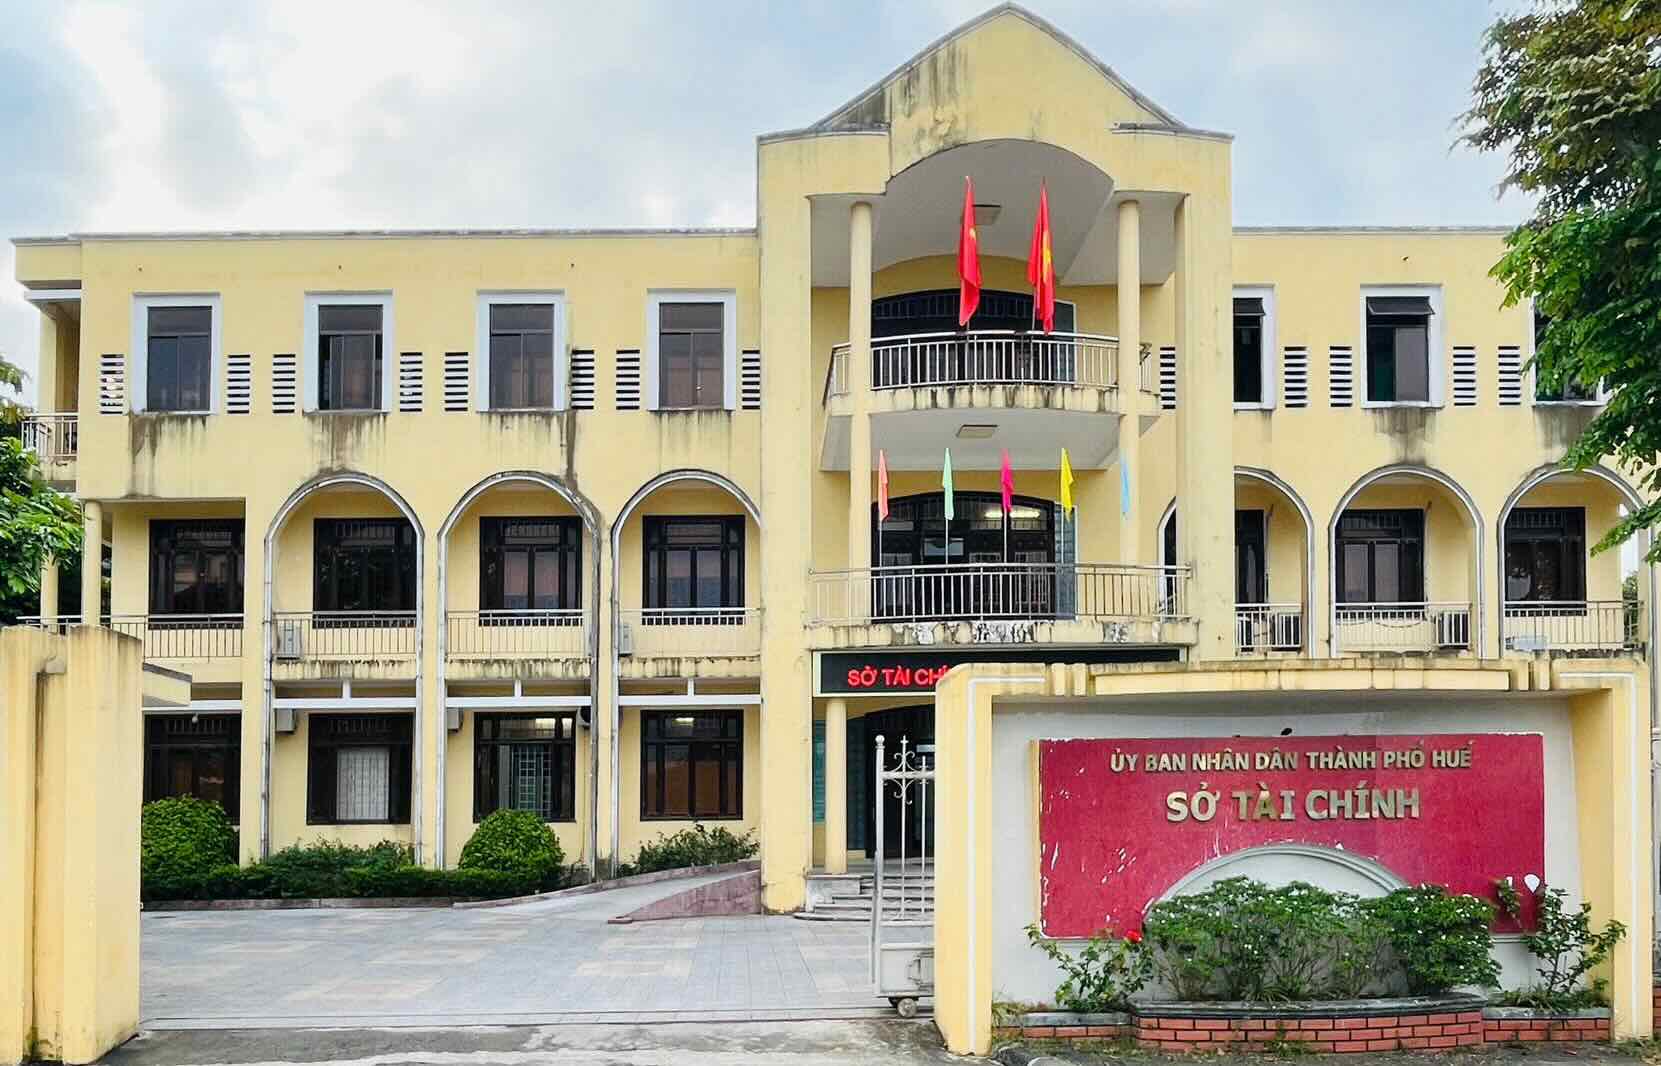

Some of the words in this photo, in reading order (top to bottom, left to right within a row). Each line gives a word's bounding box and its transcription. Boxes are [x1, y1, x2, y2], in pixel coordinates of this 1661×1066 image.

[847, 665, 877, 686] SỞ
[881, 665, 911, 686] TÀI
[1110, 747, 1138, 772] ỦY
[1144, 752, 1186, 771] BAN
[1192, 747, 1249, 771] NHÂN
[1255, 747, 1298, 771] DÂN
[1306, 745, 1376, 769] THÀNH
[1383, 739, 1425, 768] PHỐ
[1432, 739, 1475, 768] HUẾ
[1166, 781, 1221, 822] SỞ
[1231, 781, 1296, 821] TÀI
[1305, 780, 1420, 820] CHÍNH
